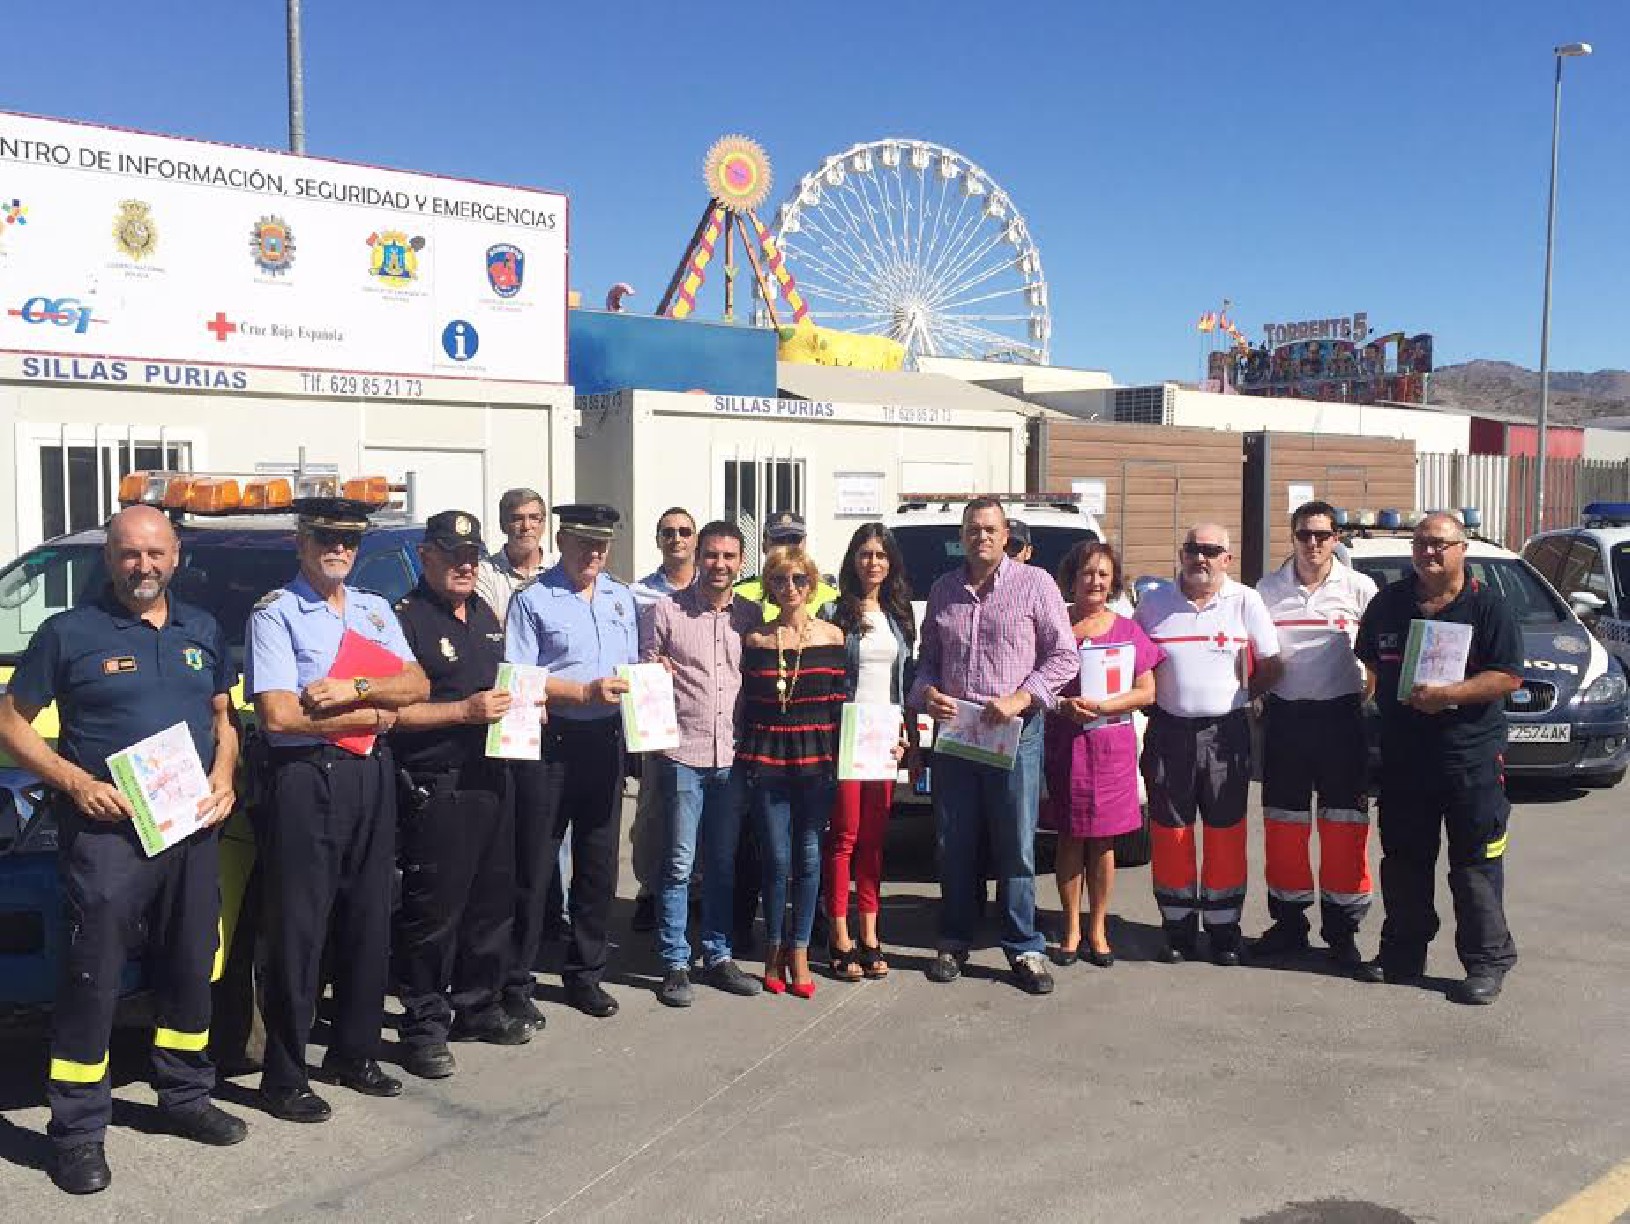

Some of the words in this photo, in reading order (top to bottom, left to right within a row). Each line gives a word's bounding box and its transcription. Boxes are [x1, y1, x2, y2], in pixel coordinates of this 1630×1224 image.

[79, 147, 112, 171] DE
[118, 154, 288, 195] INFORMACIÓN,
[295, 178, 410, 210] SEGURIDAD
[415, 196, 427, 212] Y
[432, 197, 556, 229] EMERGENCIAS
[21, 297, 93, 334] 061
[271, 323, 293, 341] Roja
[298, 325, 344, 343] Española
[1264, 317, 1351, 347] TORRENTE
[1353, 312, 1368, 342] 5
[22, 357, 128, 381] SILLAS
[145, 364, 247, 389] PURIAS
[301, 373, 325, 392] Tlf.
[330, 375, 357, 394] 629
[362, 377, 380, 395] 85
[384, 378, 400, 396] 21
[406, 379, 423, 397] 73
[714, 395, 771, 414] SILLAS
[776, 399, 835, 418] PURIAS
